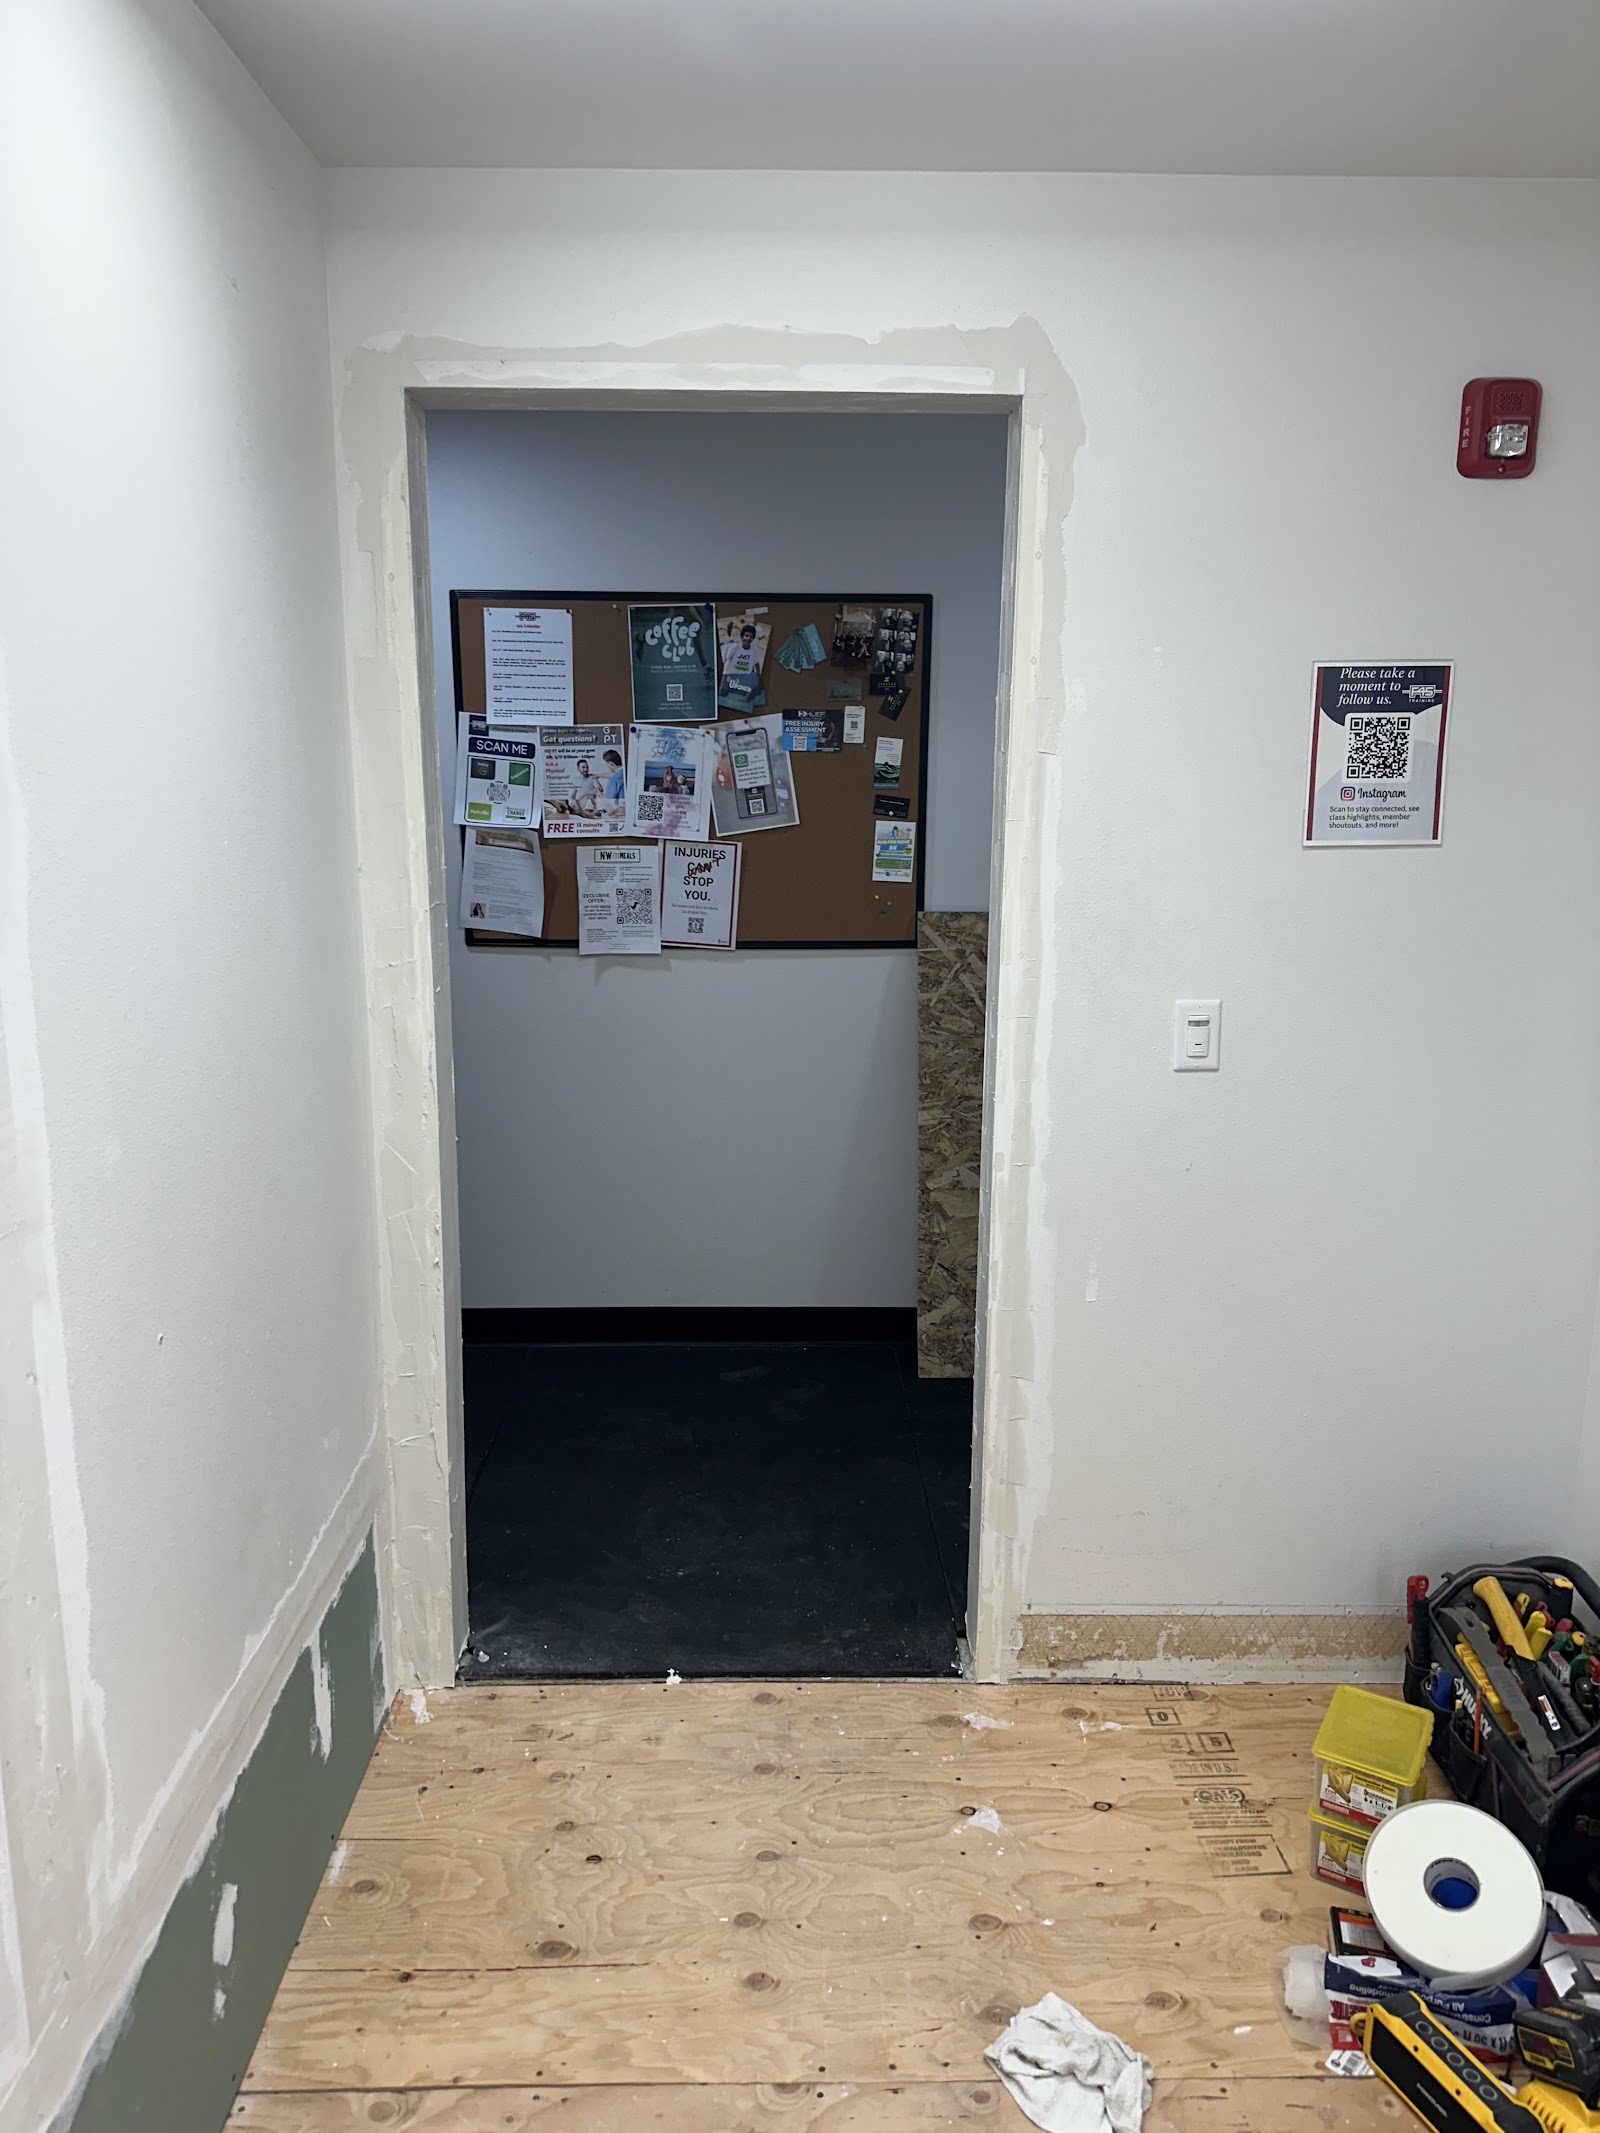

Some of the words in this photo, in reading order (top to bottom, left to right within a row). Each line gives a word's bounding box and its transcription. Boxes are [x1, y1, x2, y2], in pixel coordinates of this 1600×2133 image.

[1462, 406, 1471, 448] FIRE
[1340, 667, 1376, 679] Please
[1380, 667, 1405, 679] take
[1407, 669, 1415, 678] a
[1339, 681, 1386, 692] moment
[1389, 681, 1401, 692] to
[1409, 684, 1436, 699] F45
[1336, 694, 1374, 707] follow
[1376, 696, 1392, 705] us.
[543, 735, 557, 743] Got
[558, 735, 596, 745] questions?
[476, 740, 509, 753] SCAN
[512, 744, 528, 755] ME
[1357, 787, 1407, 802] Instagram
[1356, 806, 1370, 814] stay
[1371, 805, 1407, 814] connected,
[1347, 814, 1381, 822] highlights,
[547, 823, 574, 833] FREE
[674, 847, 726, 860] INJURIES
[683, 876, 714, 887] STOP
[684, 890, 710, 901] YOU.
[1157, 1712, 1168, 1722] 0
[1452, 2001, 1464, 2012] All
